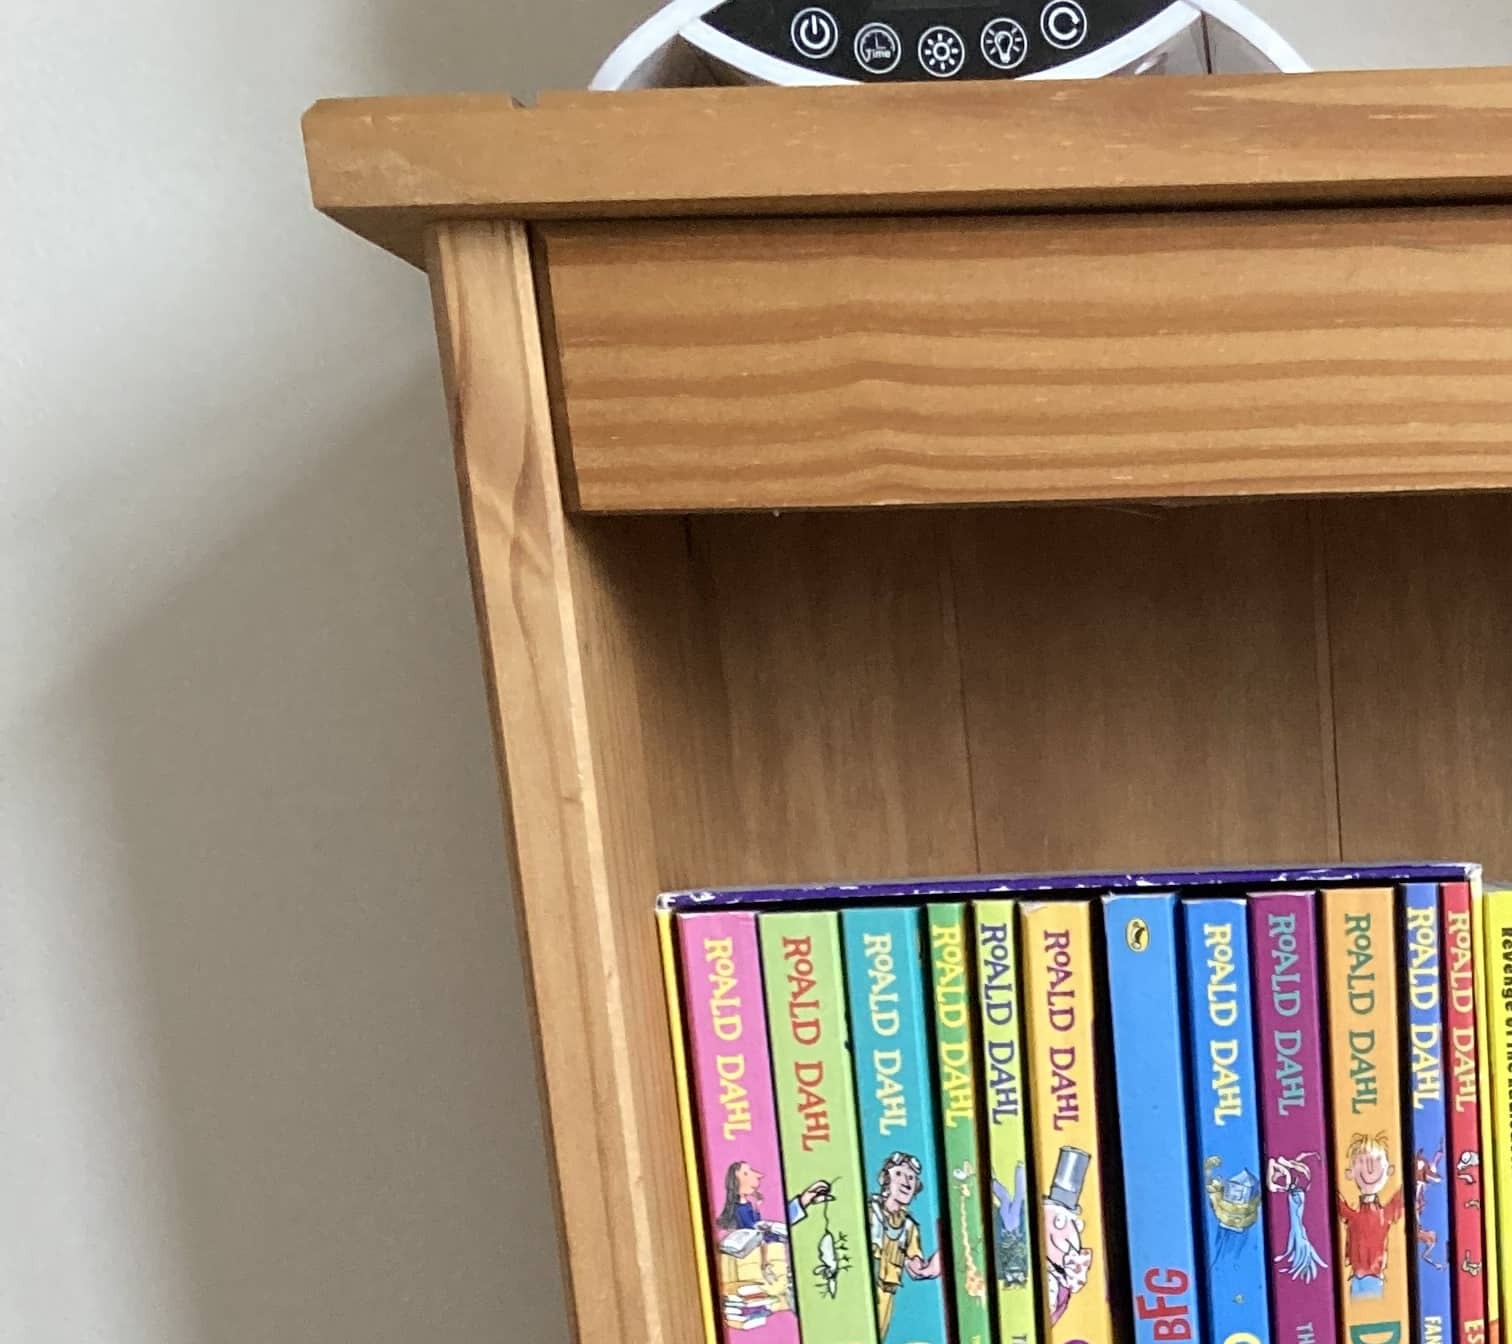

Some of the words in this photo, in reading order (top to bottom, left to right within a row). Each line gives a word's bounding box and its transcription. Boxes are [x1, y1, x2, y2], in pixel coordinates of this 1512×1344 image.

[703, 937, 741, 1040] ROALD
[783, 936, 820, 1045] ROALD
[864, 934, 900, 1035] ROALD
[932, 924, 968, 1028] ROALD
[981, 924, 1013, 1025] ROALD
[1044, 930, 1075, 1031] ROALD
[1204, 924, 1237, 1026] ROALD
[1268, 913, 1301, 1016] ROALD
[1344, 913, 1375, 1015] ROALD
[1406, 907, 1441, 1009] ROALD
[1448, 911, 1474, 1013] ROALD
[716, 1056, 751, 1140] DAHL
[798, 1061, 830, 1151] DAHL
[875, 1050, 906, 1135] DAHL
[939, 1041, 972, 1127] DAHL
[988, 1041, 1018, 1125] DAHL
[1050, 1048, 1079, 1130] DAHL
[1210, 1040, 1241, 1125] DAHL
[1275, 1030, 1305, 1115] DAHL
[1350, 1031, 1379, 1114] DAHL
[1410, 1023, 1441, 1108] DAHL
[1452, 1027, 1478, 1112] DAHL
[1136, 1268, 1191, 1340] BFG
